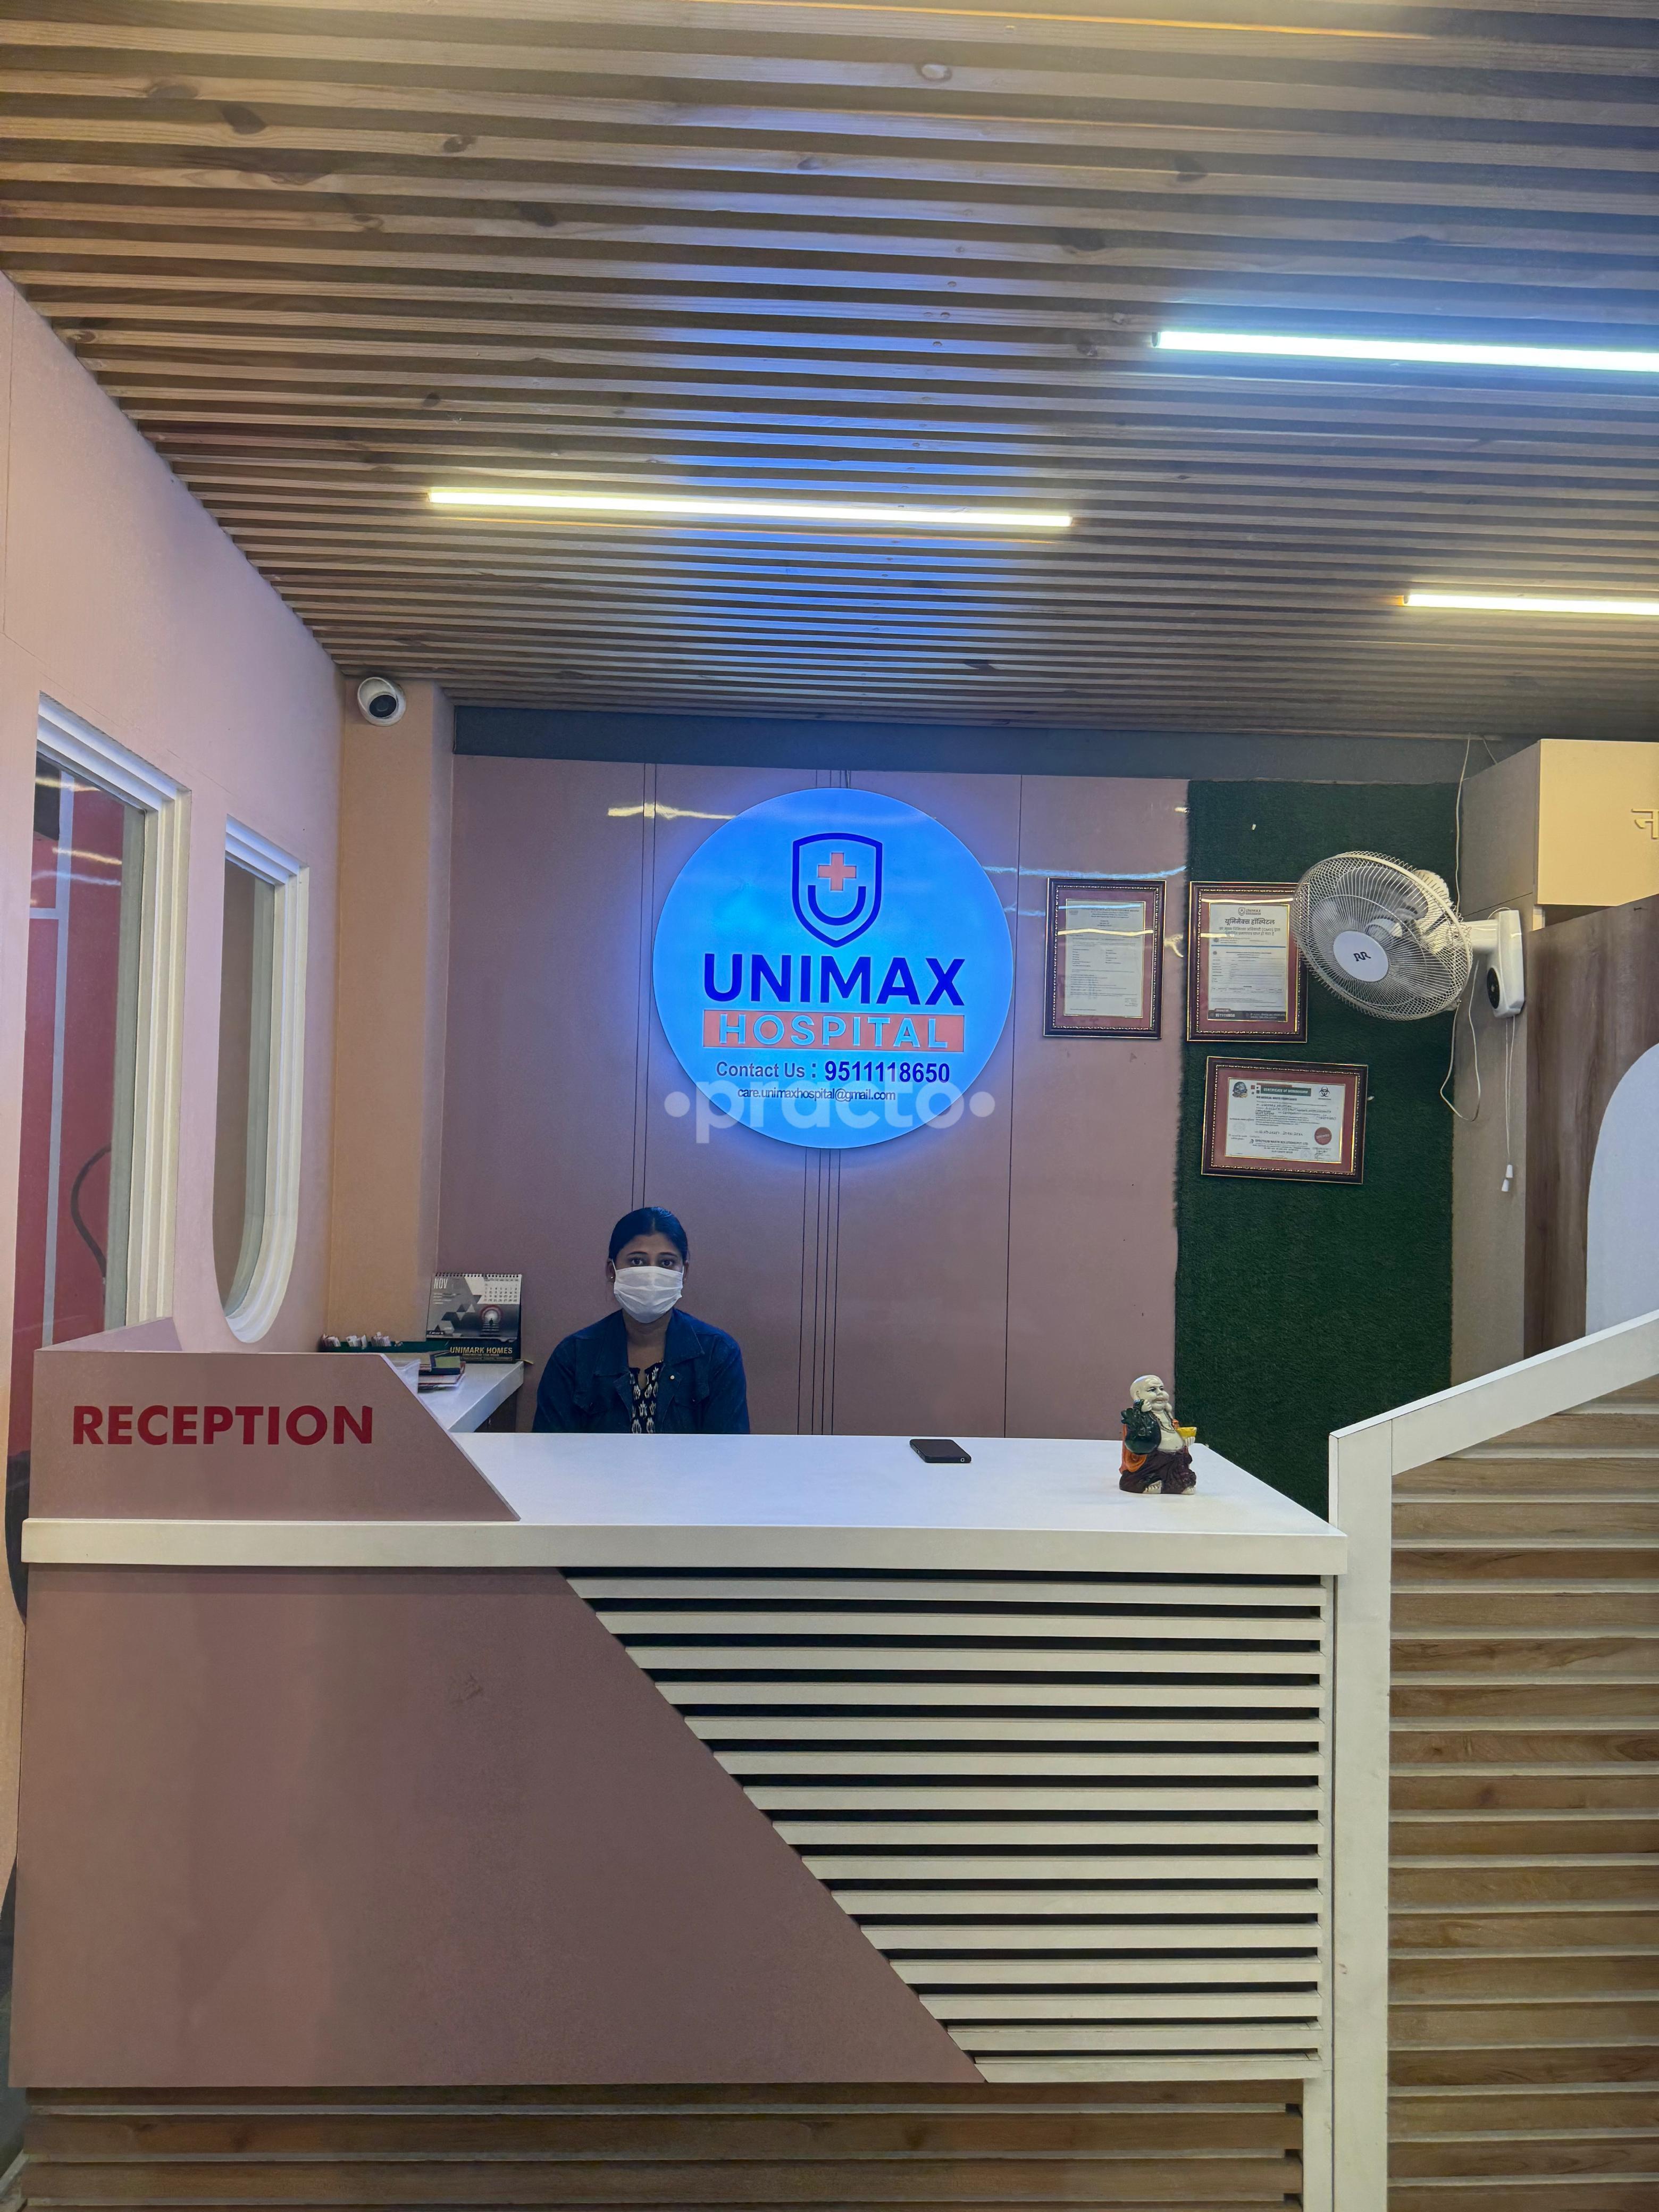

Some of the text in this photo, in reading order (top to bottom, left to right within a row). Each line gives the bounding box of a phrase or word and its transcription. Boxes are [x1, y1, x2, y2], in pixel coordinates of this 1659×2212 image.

[704, 953, 965, 1006] UNIMAX
[719, 1014, 948, 1049] HOSPITAL
[716, 1061, 779, 1078] Contact
[784, 1062, 805, 1078] Us
[824, 1060, 950, 1083] 9511118650
[738, 1087, 896, 1102] care.unimaxhospital@gmail.com
[434, 1278, 448, 1289] NOV
[73, 1405, 373, 1445] RECEPTION
